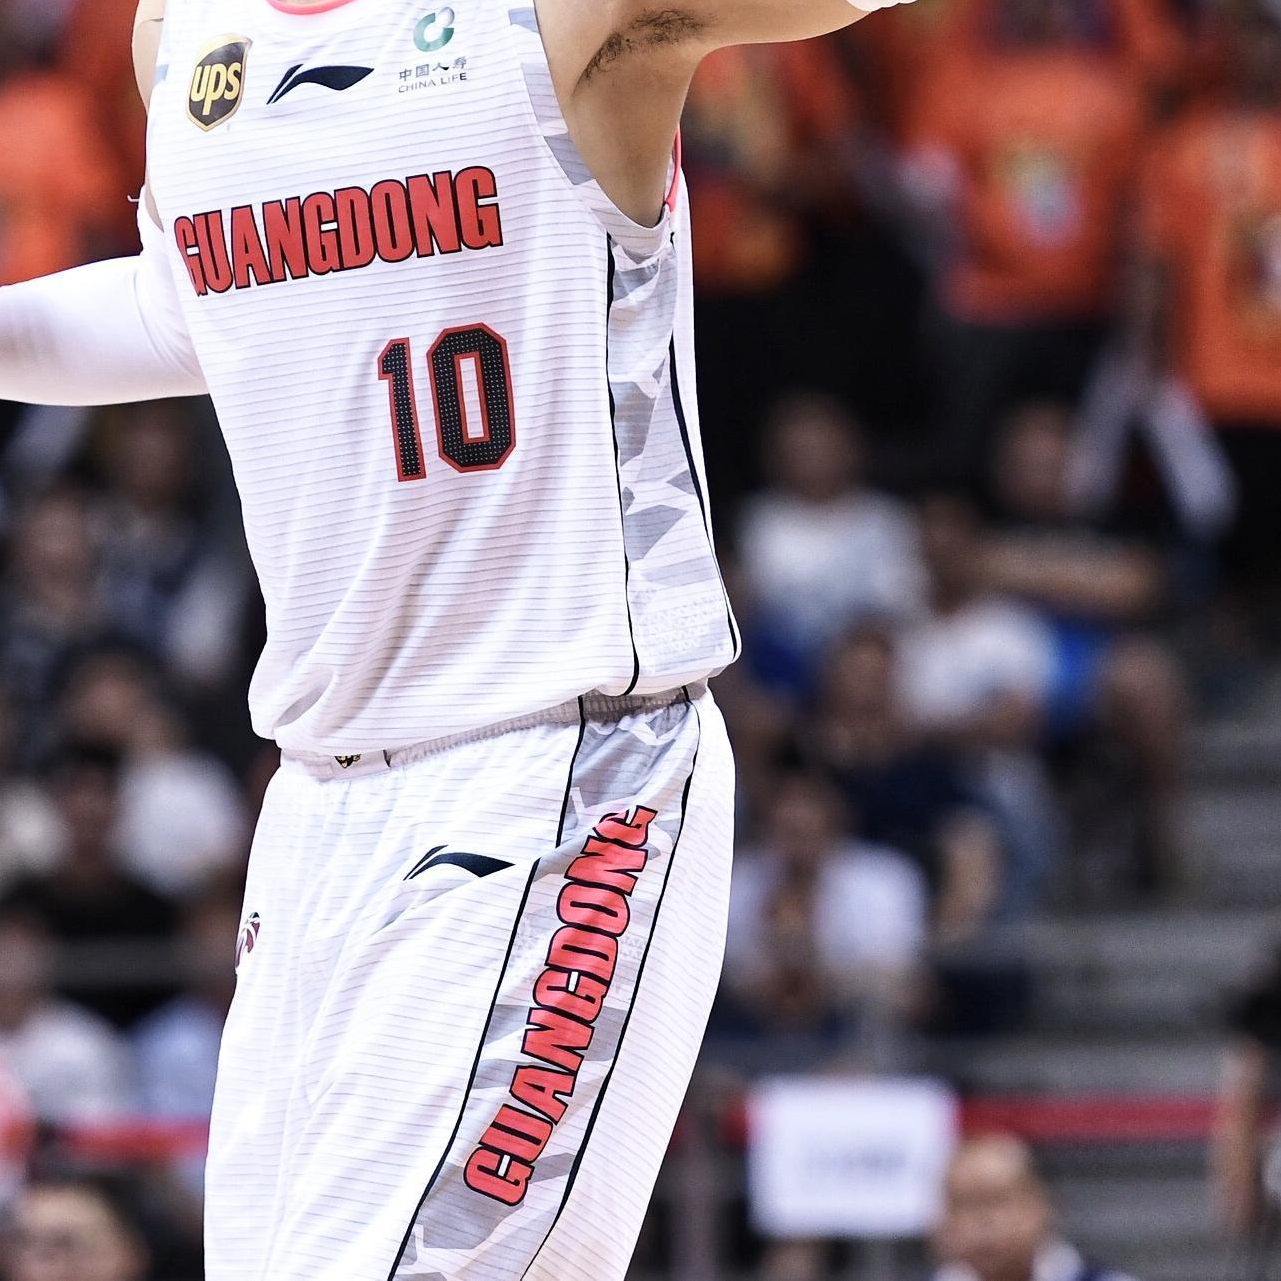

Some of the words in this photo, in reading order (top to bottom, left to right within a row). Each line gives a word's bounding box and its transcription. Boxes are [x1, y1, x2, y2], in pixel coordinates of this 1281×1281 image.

[190, 62, 242, 116] ups
[398, 79, 437, 93] CHINA
[440, 72, 467, 85] LIFE
[399, 56, 467, 81] 中国人寿
[174, 166, 503, 297] GUANGDONG
[377, 322, 517, 482] 10
[463, 804, 658, 1206] GUANGDONG
